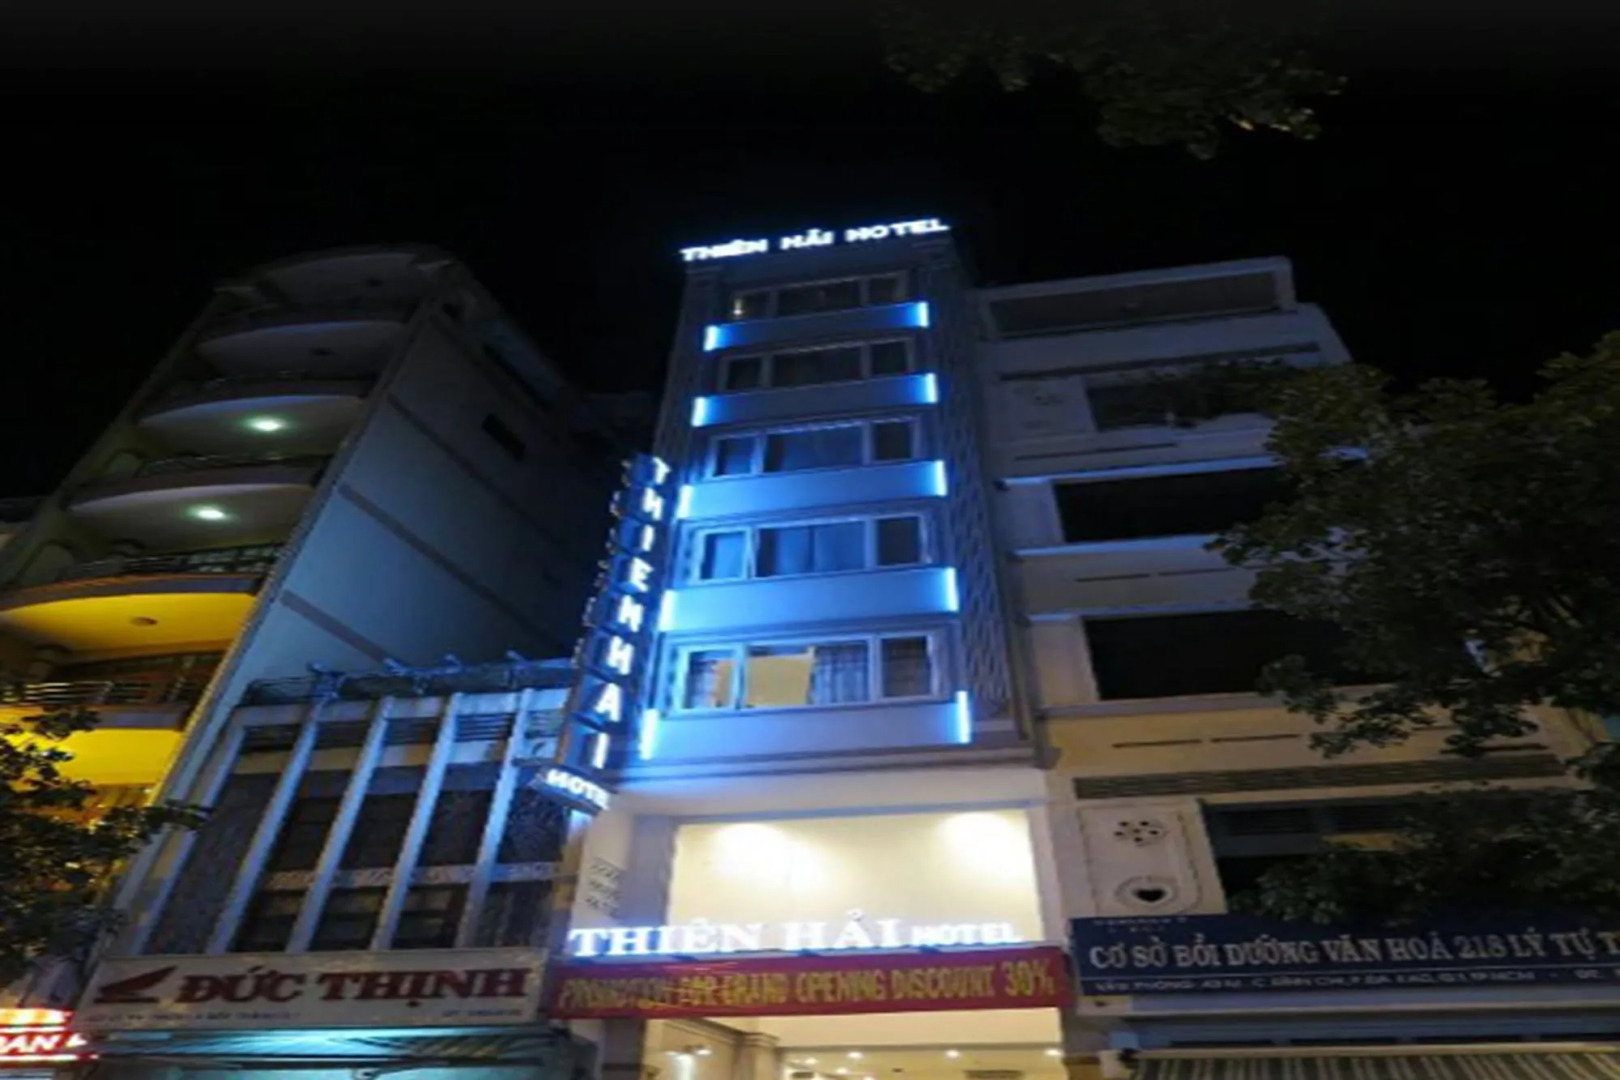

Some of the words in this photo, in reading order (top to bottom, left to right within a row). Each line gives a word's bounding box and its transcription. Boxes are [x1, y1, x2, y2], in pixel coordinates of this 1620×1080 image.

[680, 239, 768, 261] THIÊN
[845, 218, 950, 242] HOTEL
[570, 917, 763, 957] THIÊN
[784, 908, 904, 951] HẢI
[911, 922, 1024, 947] HOTEL
[1453, 934, 1508, 960] 218
[173, 965, 304, 1003] ĐỨC
[316, 967, 531, 1007] THỊNH
[796, 968, 886, 1003] OPENING
[890, 966, 996, 999] DISCOUNT
[1002, 958, 1056, 996] 30%
